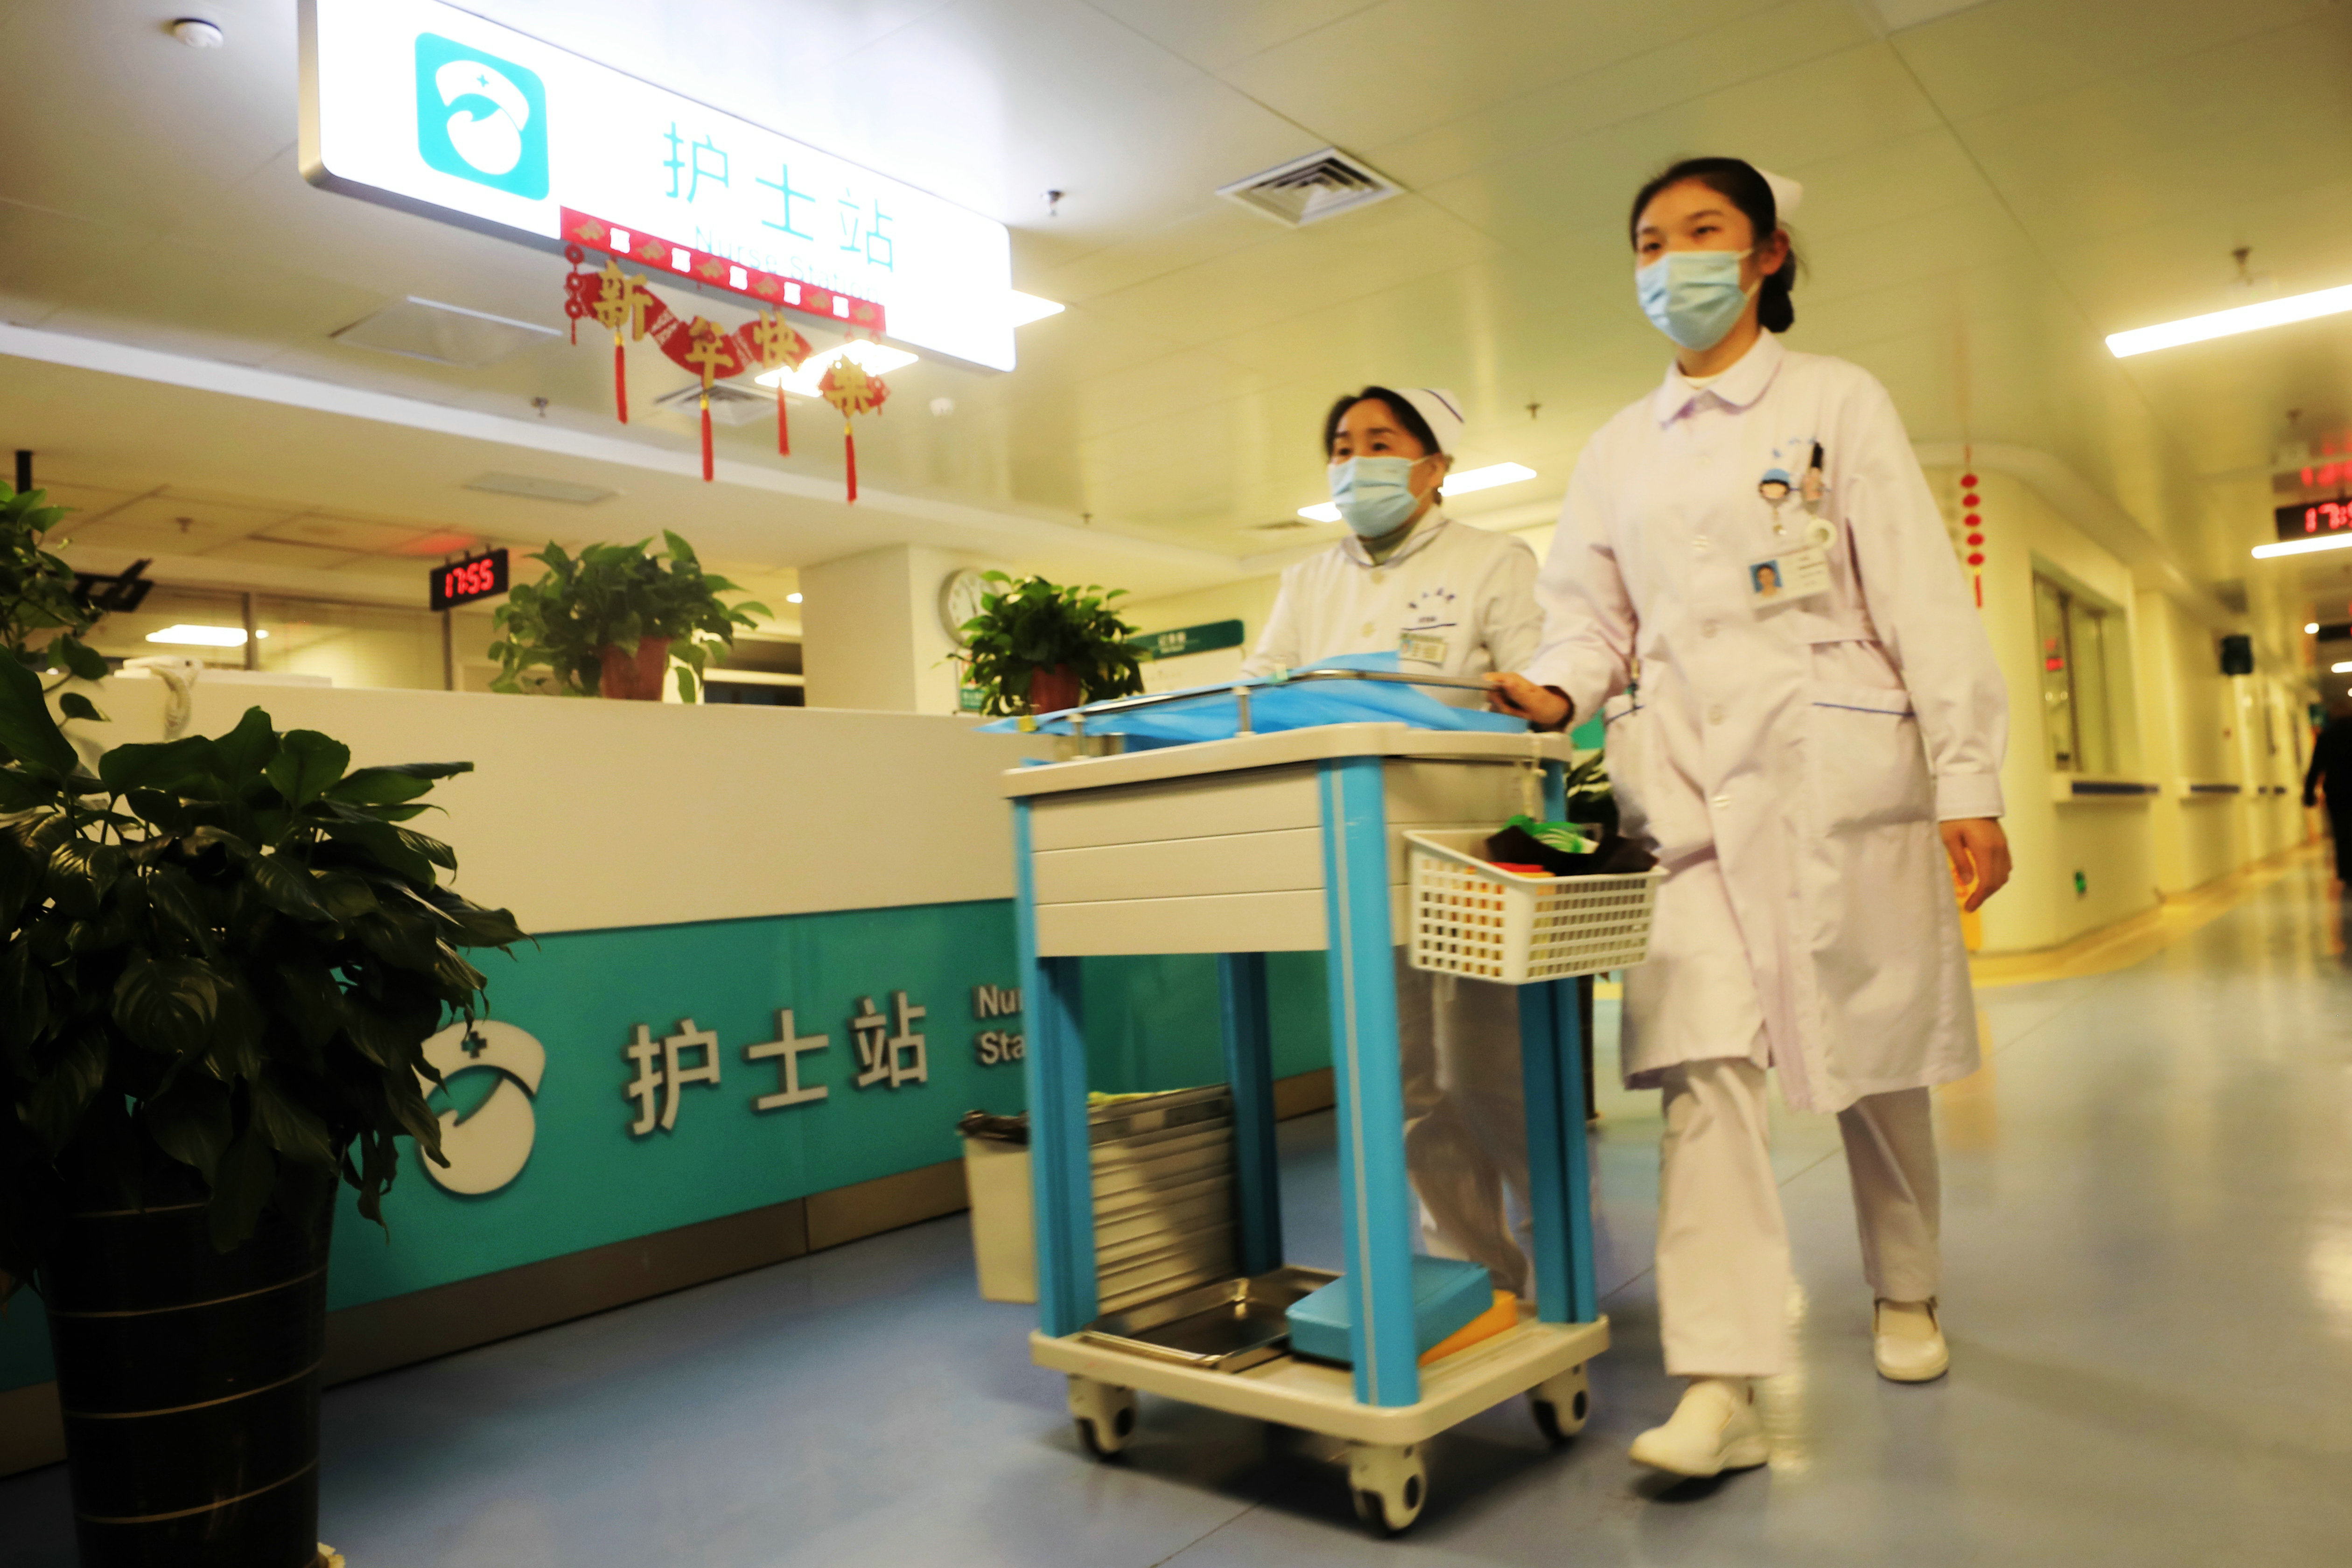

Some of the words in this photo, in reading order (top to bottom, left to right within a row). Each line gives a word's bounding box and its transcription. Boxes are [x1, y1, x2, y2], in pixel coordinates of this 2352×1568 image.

[663, 121, 893, 273] 护士站
[694, 224, 778, 274] Nurse
[624, 990, 928, 1136] 护士站
